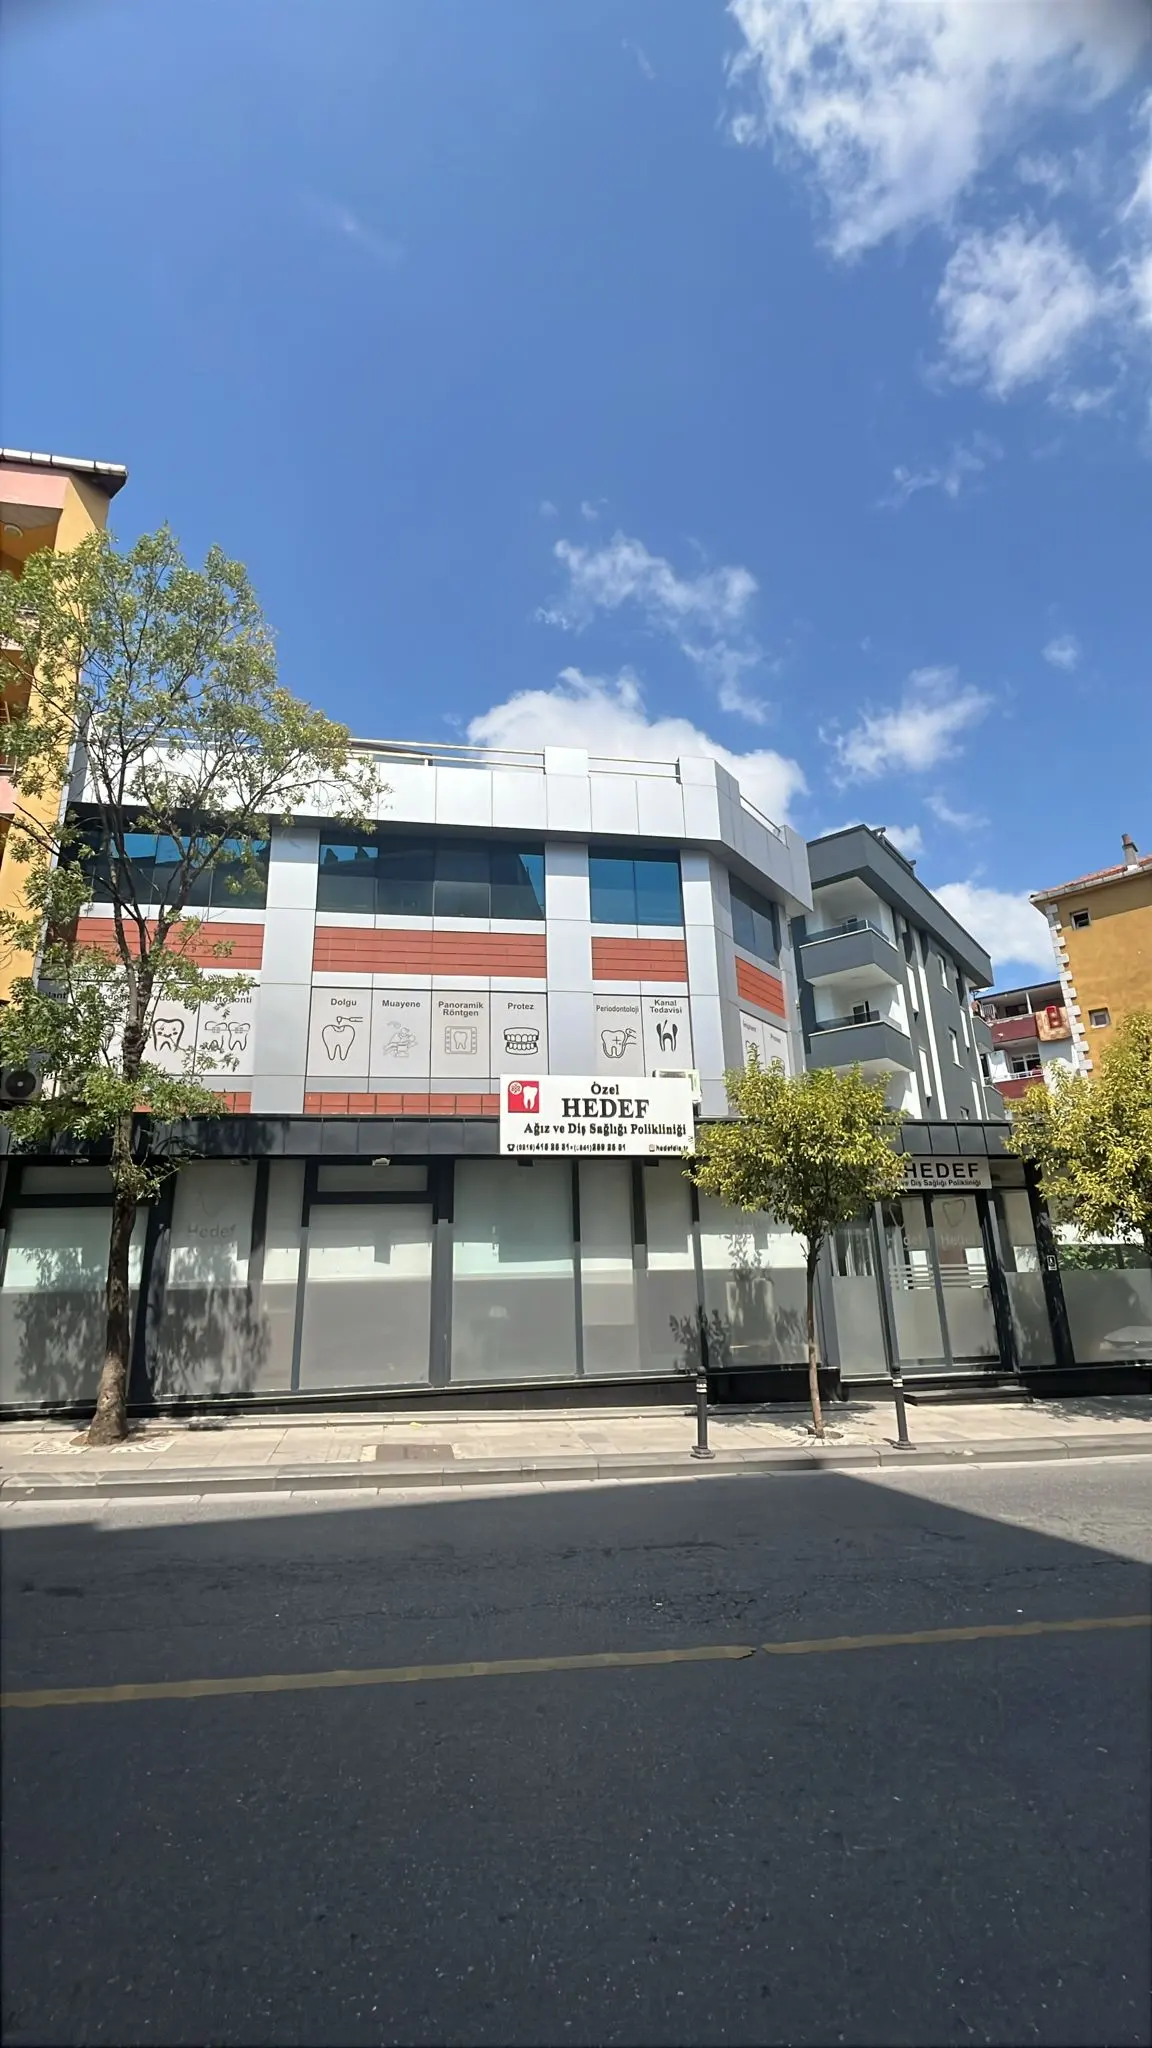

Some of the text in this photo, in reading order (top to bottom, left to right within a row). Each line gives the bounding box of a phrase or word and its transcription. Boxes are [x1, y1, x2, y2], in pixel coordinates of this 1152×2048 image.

[330, 998, 357, 1007] Dolgu
[382, 999, 421, 1009] Muayene
[438, 1001, 484, 1010] Panoramik
[507, 1002, 535, 1010] Protez
[654, 999, 677, 1007] Kanal
[443, 1009, 479, 1018] Röntgen
[596, 1005, 639, 1013] Periodontoloji
[650, 1006, 683, 1014] Tedavisi
[590, 1081, 619, 1095] Özel
[561, 1098, 649, 1118] HEDEF
[524, 1123, 687, 1137] Ağız ve Diş Sağlığı Polikliniği
[904, 1162, 978, 1178] HEDEF
[911, 1179, 922, 1187] Diş
[923, 1179, 947, 1187] Sağlığı
